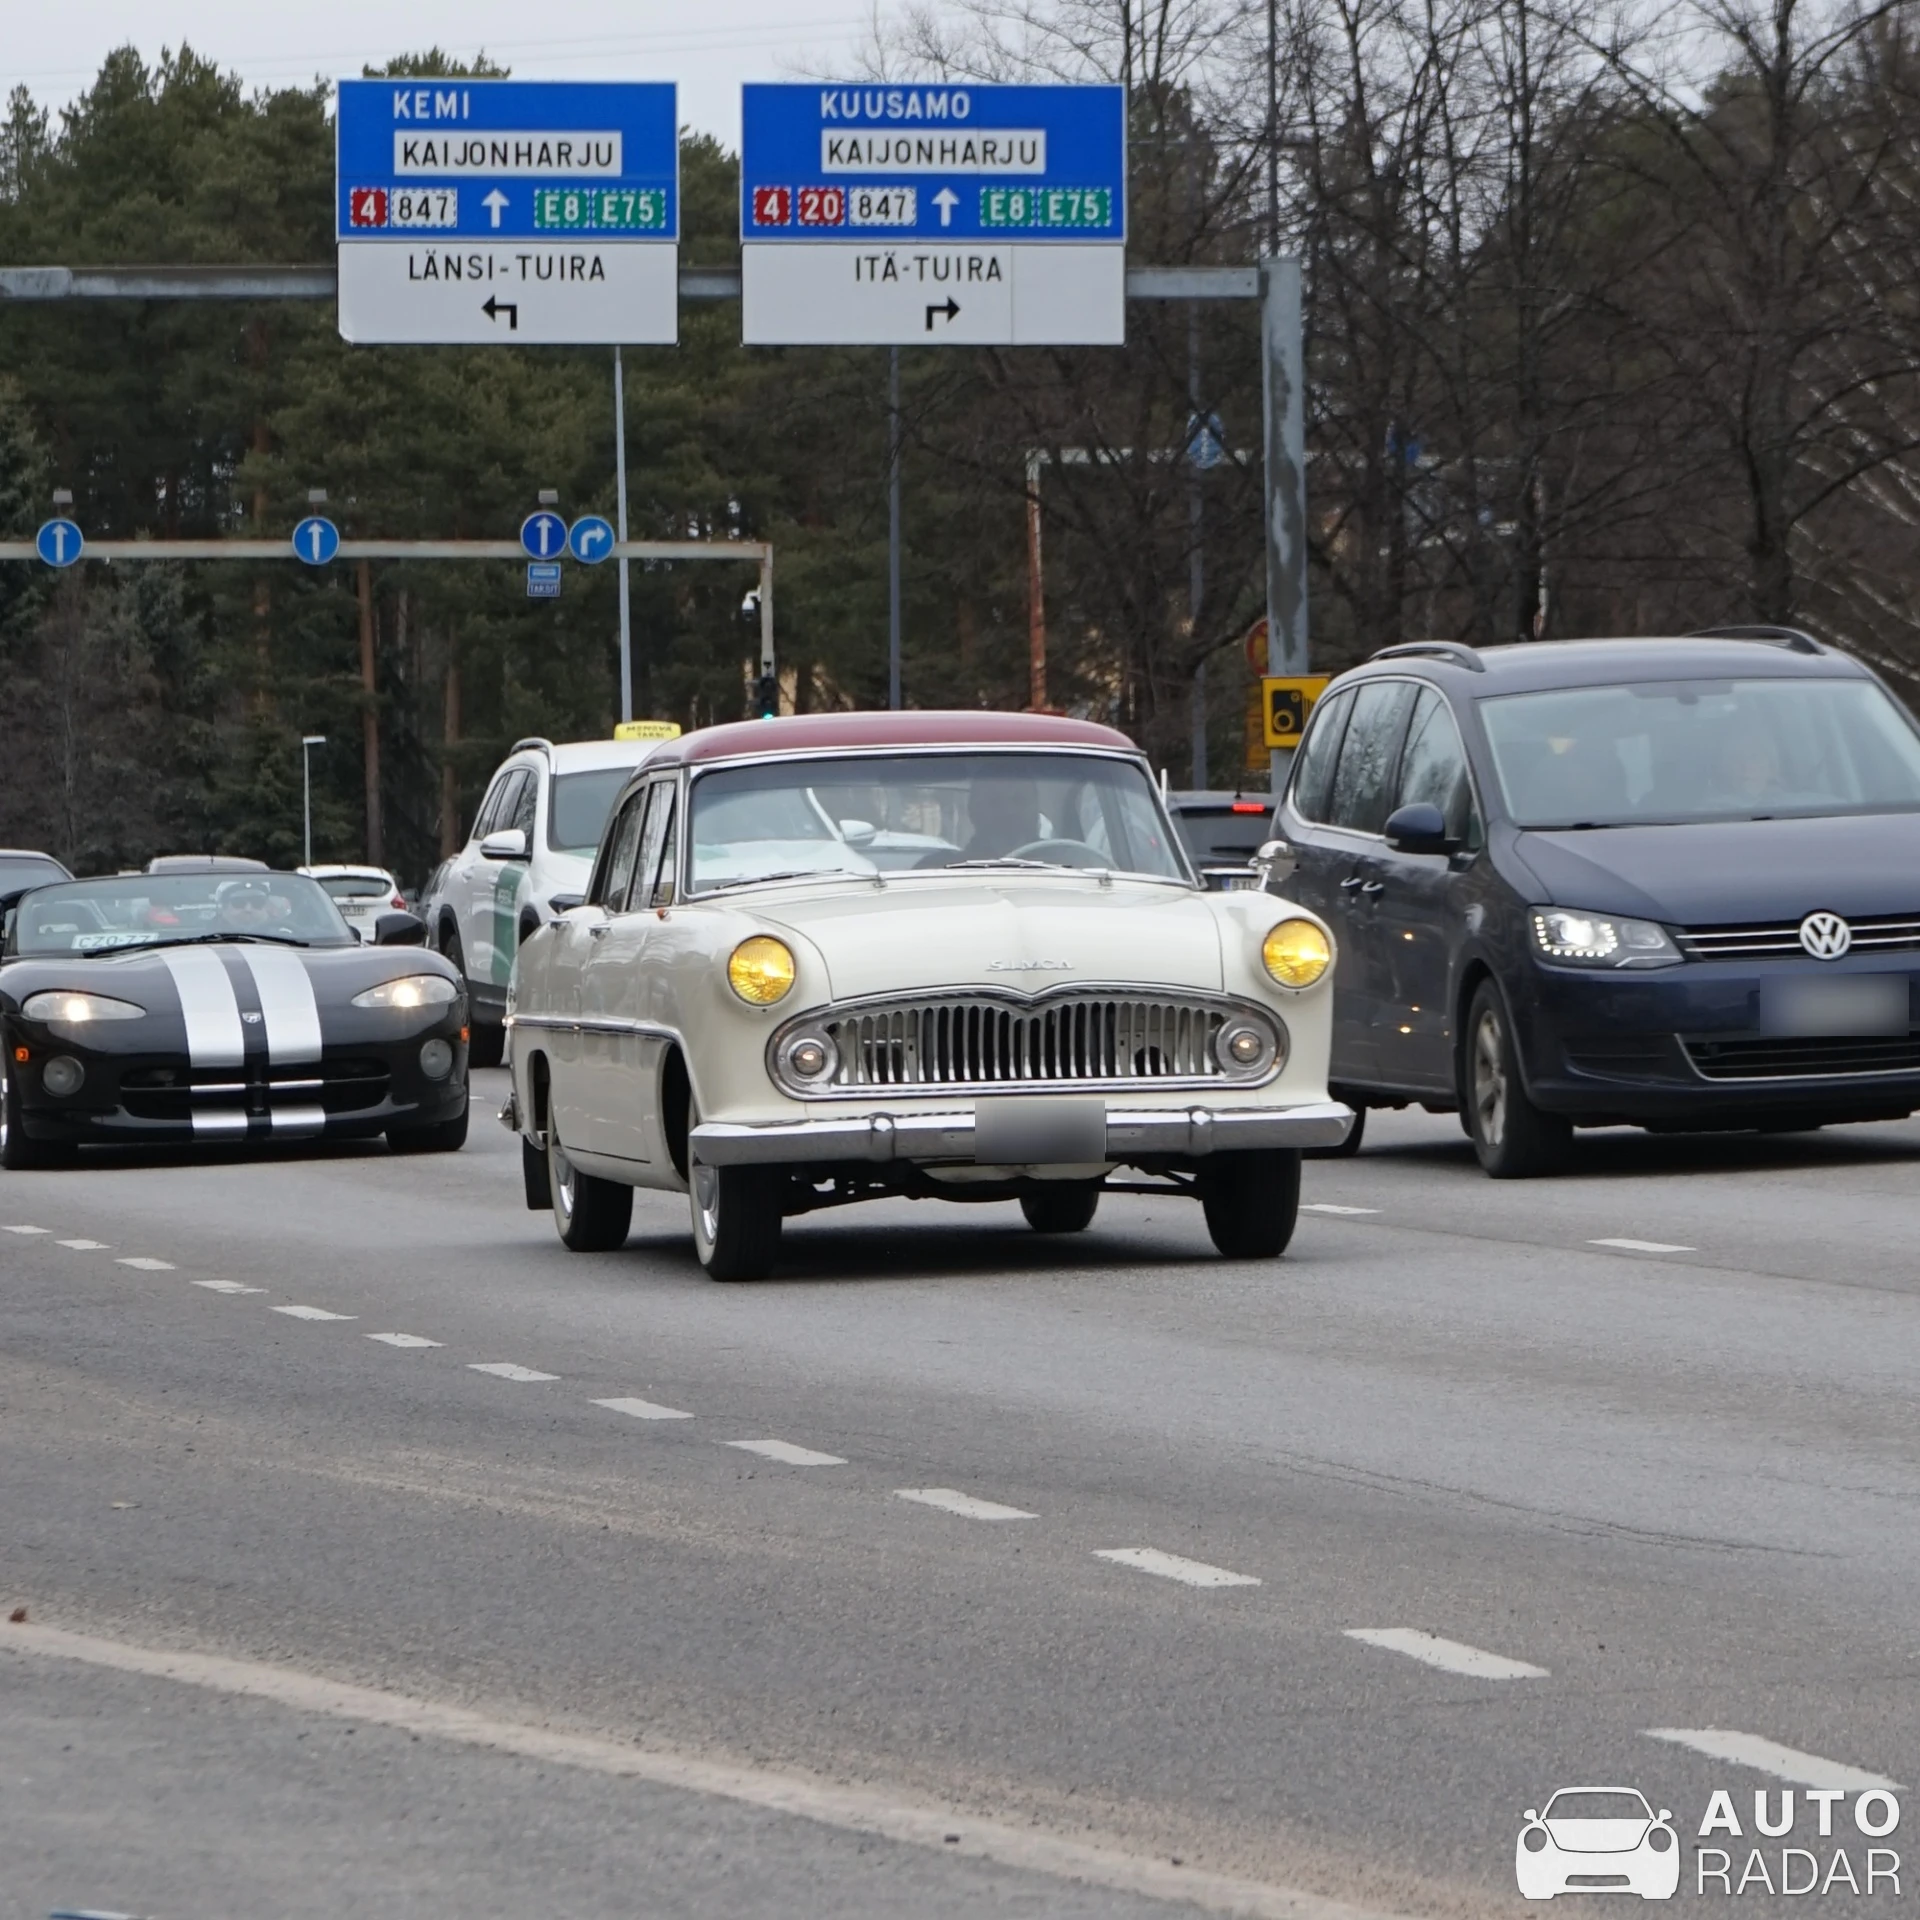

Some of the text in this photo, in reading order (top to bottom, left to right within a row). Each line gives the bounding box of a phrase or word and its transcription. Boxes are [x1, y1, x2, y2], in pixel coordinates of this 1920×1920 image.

[393, 90, 469, 119] KEMI
[820, 91, 970, 119] KUUSAMO
[402, 141, 614, 168] KAIJONHARJU
[827, 139, 1037, 165] KAIJONHARJU
[360, 194, 655, 222] 4 847 E8 E75
[763, 194, 1099, 221] 4 20 847 E8 E75
[408, 249, 606, 281] LÄNSI-TUIRA
[855, 252, 1002, 282] ITÄ-TUIRA
[987, 959, 1074, 971] SIMCA
